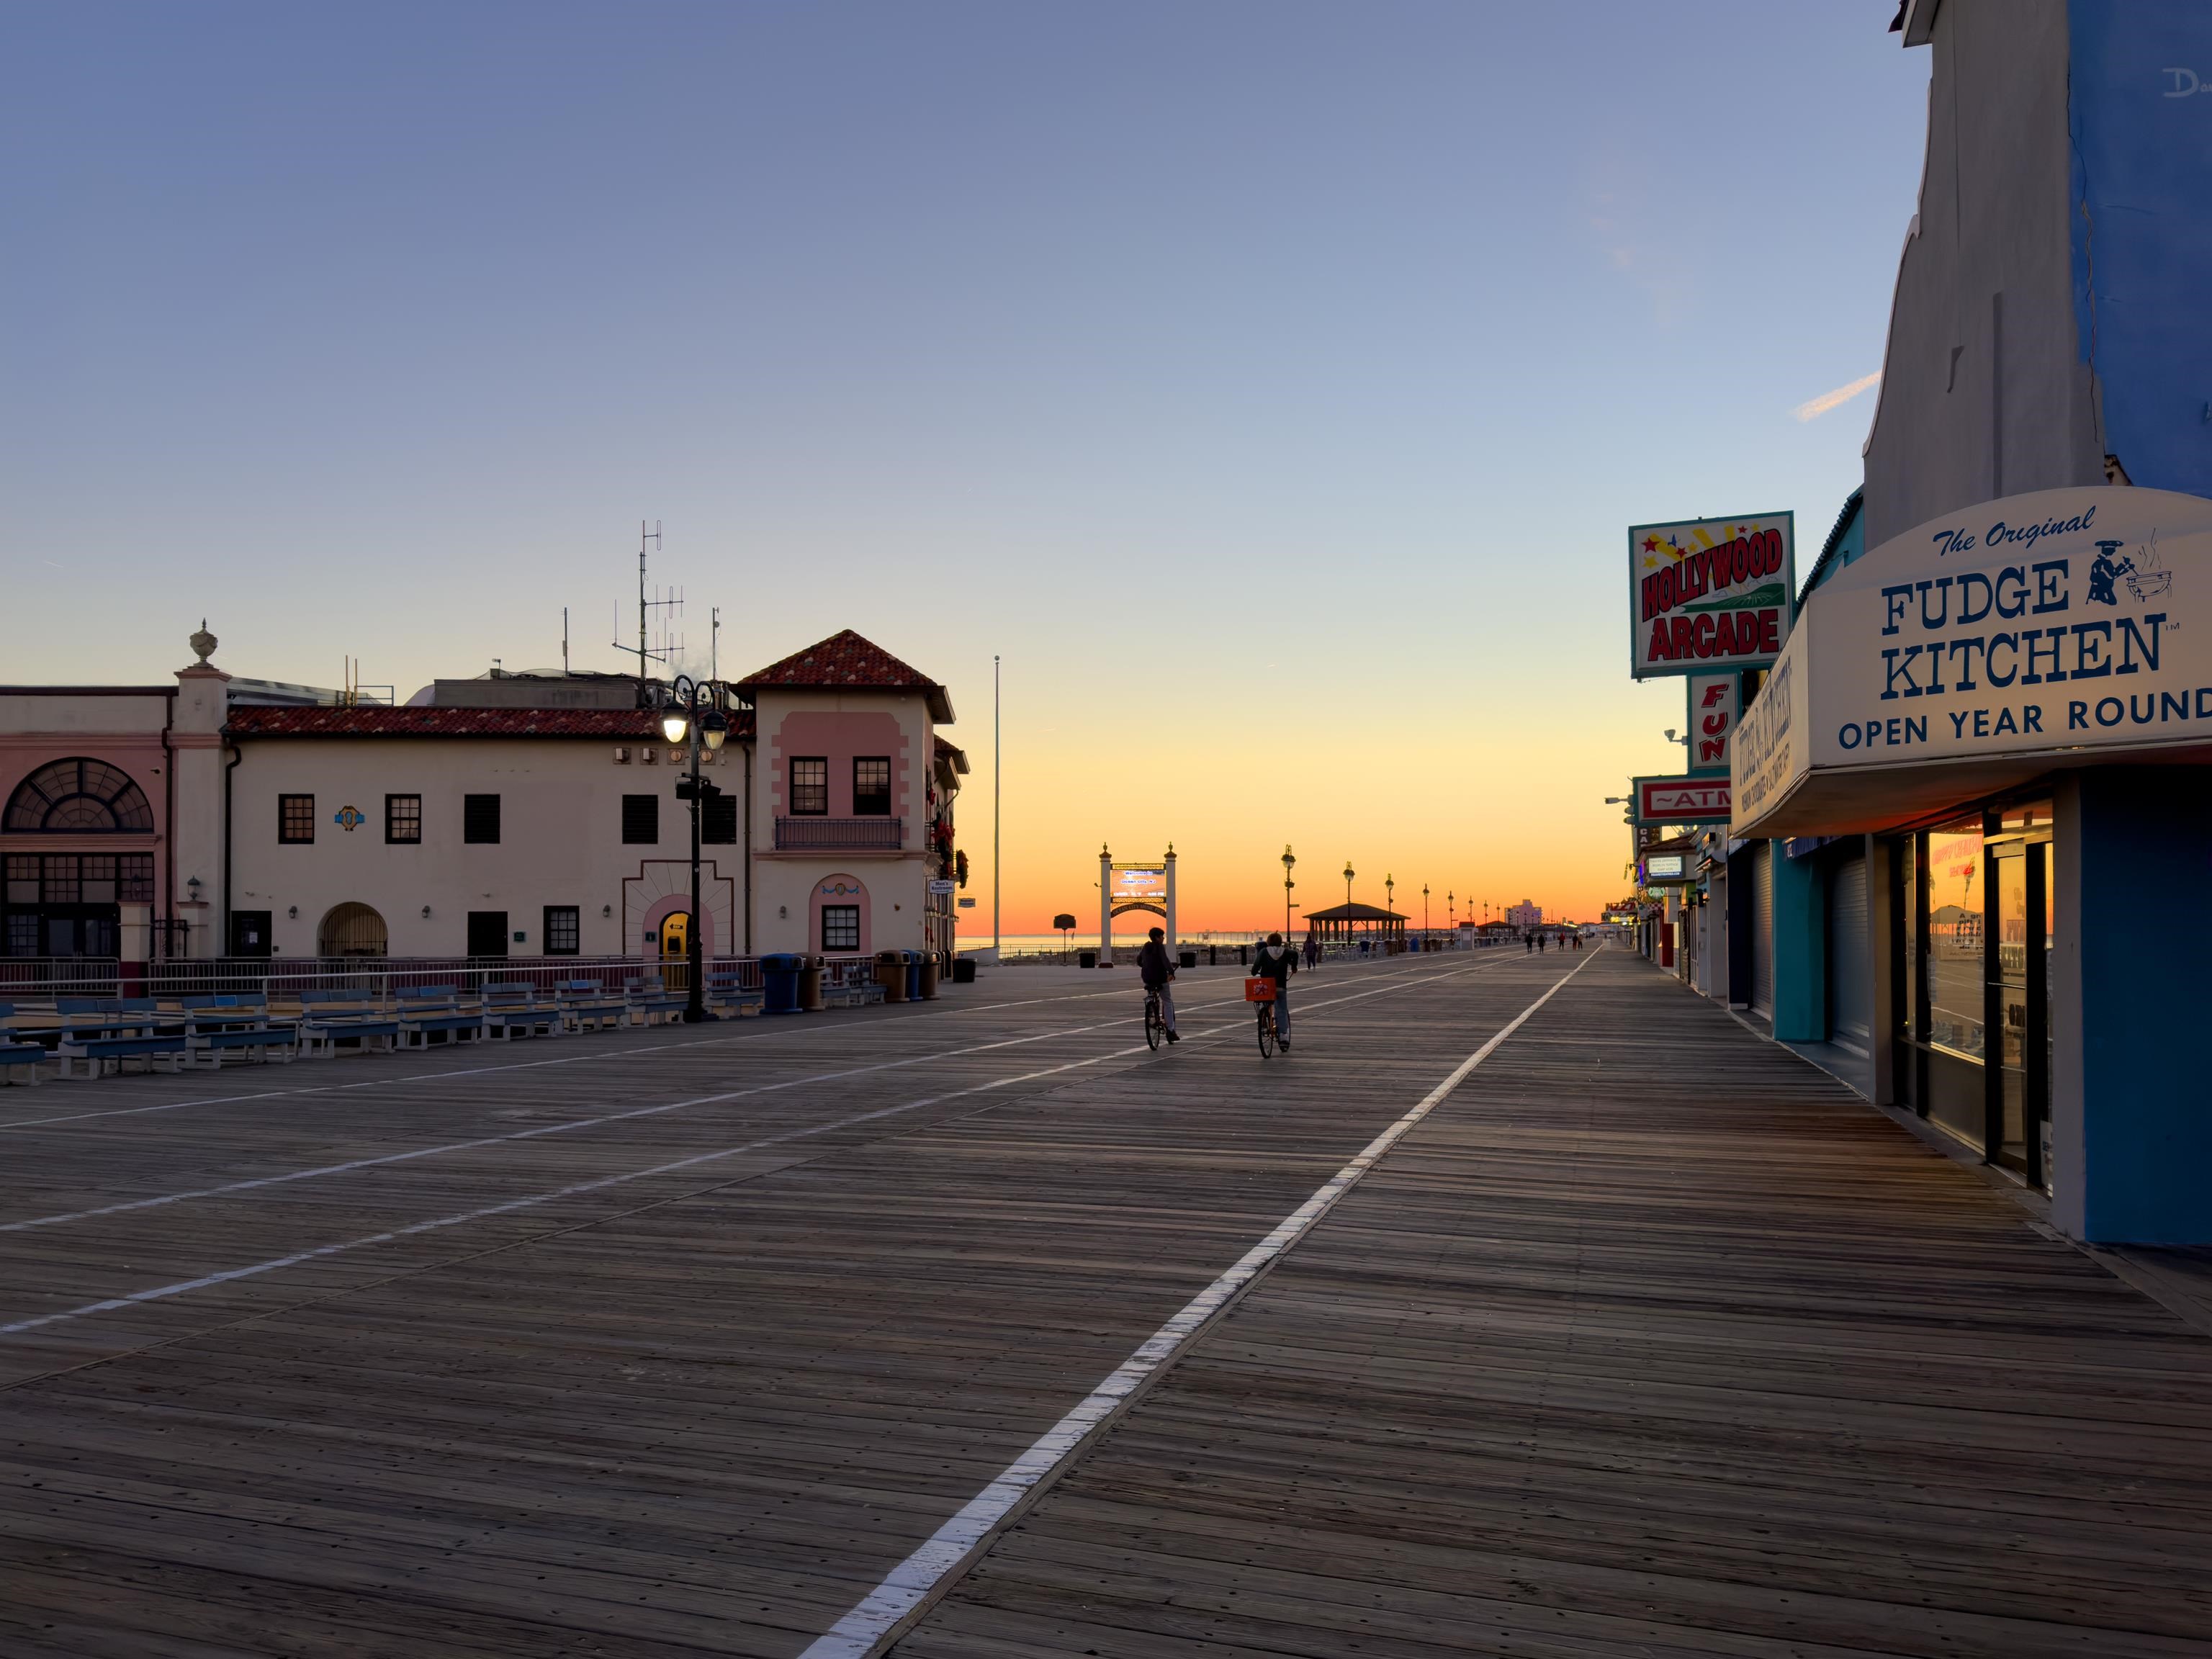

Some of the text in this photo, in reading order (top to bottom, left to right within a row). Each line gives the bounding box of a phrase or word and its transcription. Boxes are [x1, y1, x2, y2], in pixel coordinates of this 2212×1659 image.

[1933, 505, 2096, 557] The Original
[1642, 528, 1783, 623] HOLLYWOOD
[1881, 559, 2069, 635] FUDGE
[1647, 608, 1779, 662] ARCADE
[1880, 613, 2166, 700] KITCHEN
[1699, 683, 1730, 763] FUN
[1838, 687, 2212, 750] OPEN YEAR ROUND
